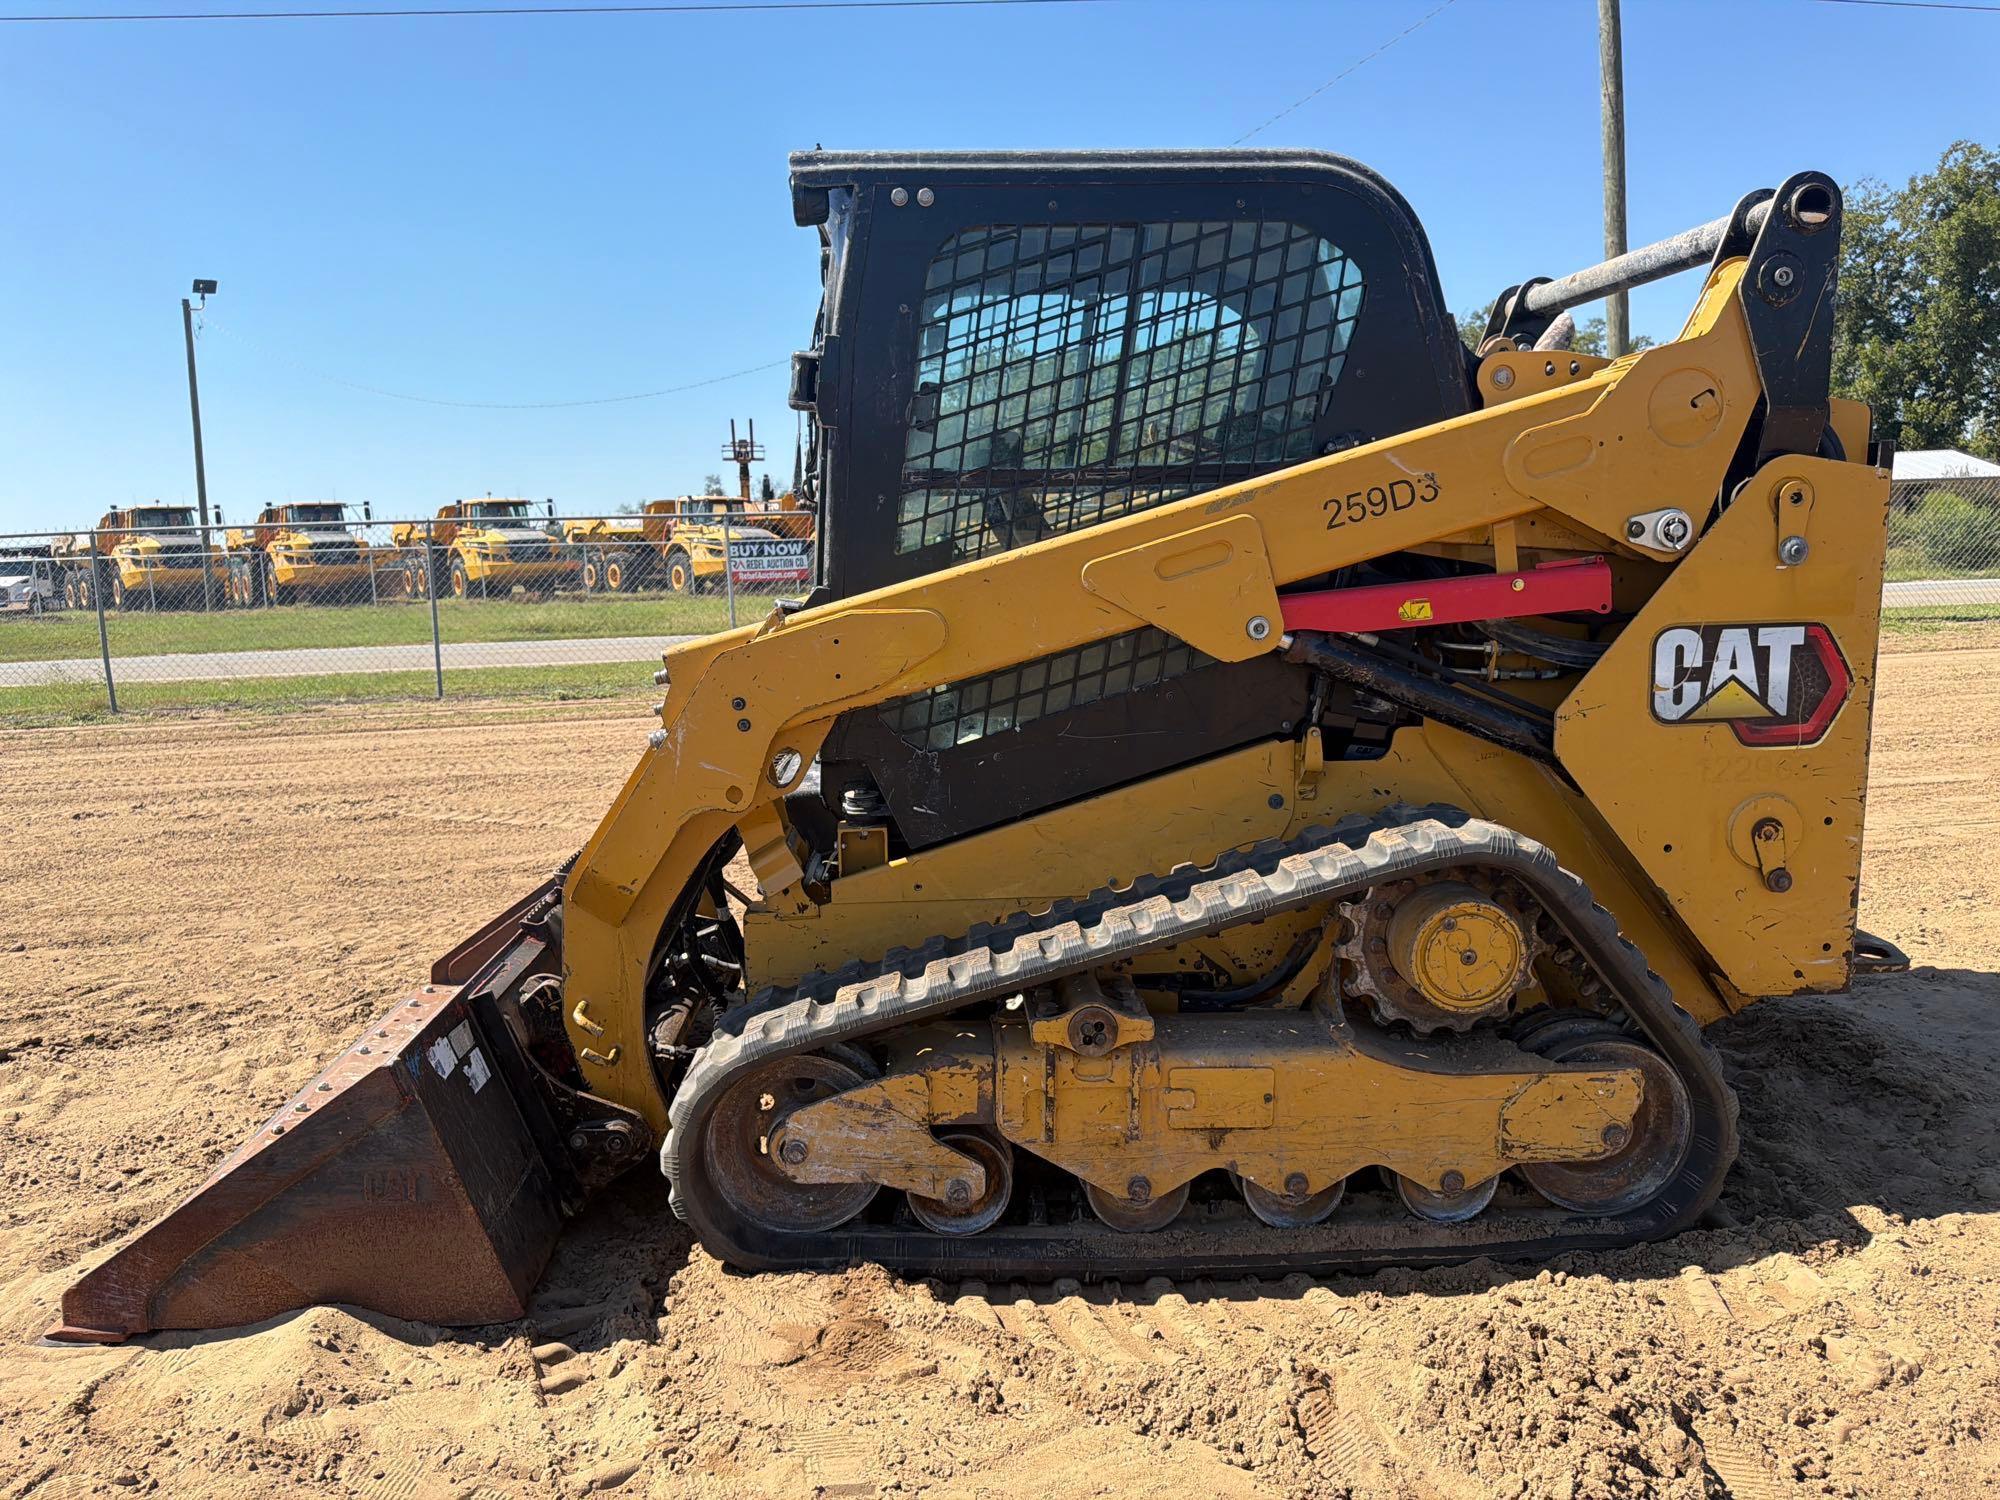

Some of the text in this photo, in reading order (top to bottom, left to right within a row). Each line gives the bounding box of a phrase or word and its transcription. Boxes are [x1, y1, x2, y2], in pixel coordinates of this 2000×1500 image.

[1323, 479, 1440, 530] 259D3
[730, 543, 803, 557] BUY NOW
[746, 559, 765, 569] REBEL
[767, 558, 794, 569] AUCTION
[1654, 626, 1806, 721] CAT
